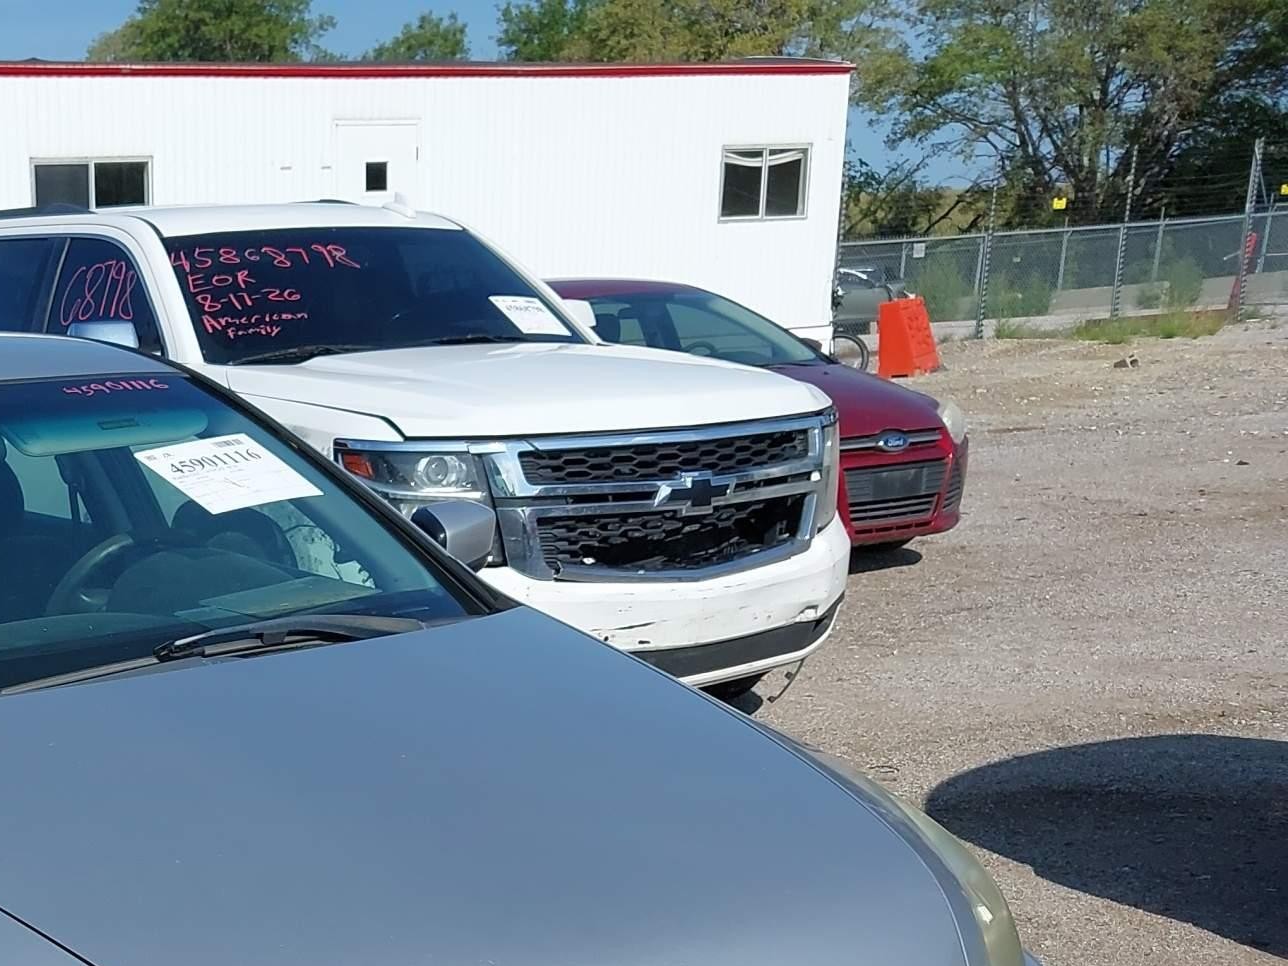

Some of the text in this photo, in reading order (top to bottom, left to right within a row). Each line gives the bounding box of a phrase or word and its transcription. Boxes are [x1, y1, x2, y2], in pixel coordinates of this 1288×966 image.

[60, 261, 137, 325] 68798
[187, 270, 256, 293] EOR
[196, 289, 301, 312] 8-17-26
[201, 313, 309, 334] American
[62, 379, 169, 396] 45901116
[170, 448, 263, 474] 45901116
